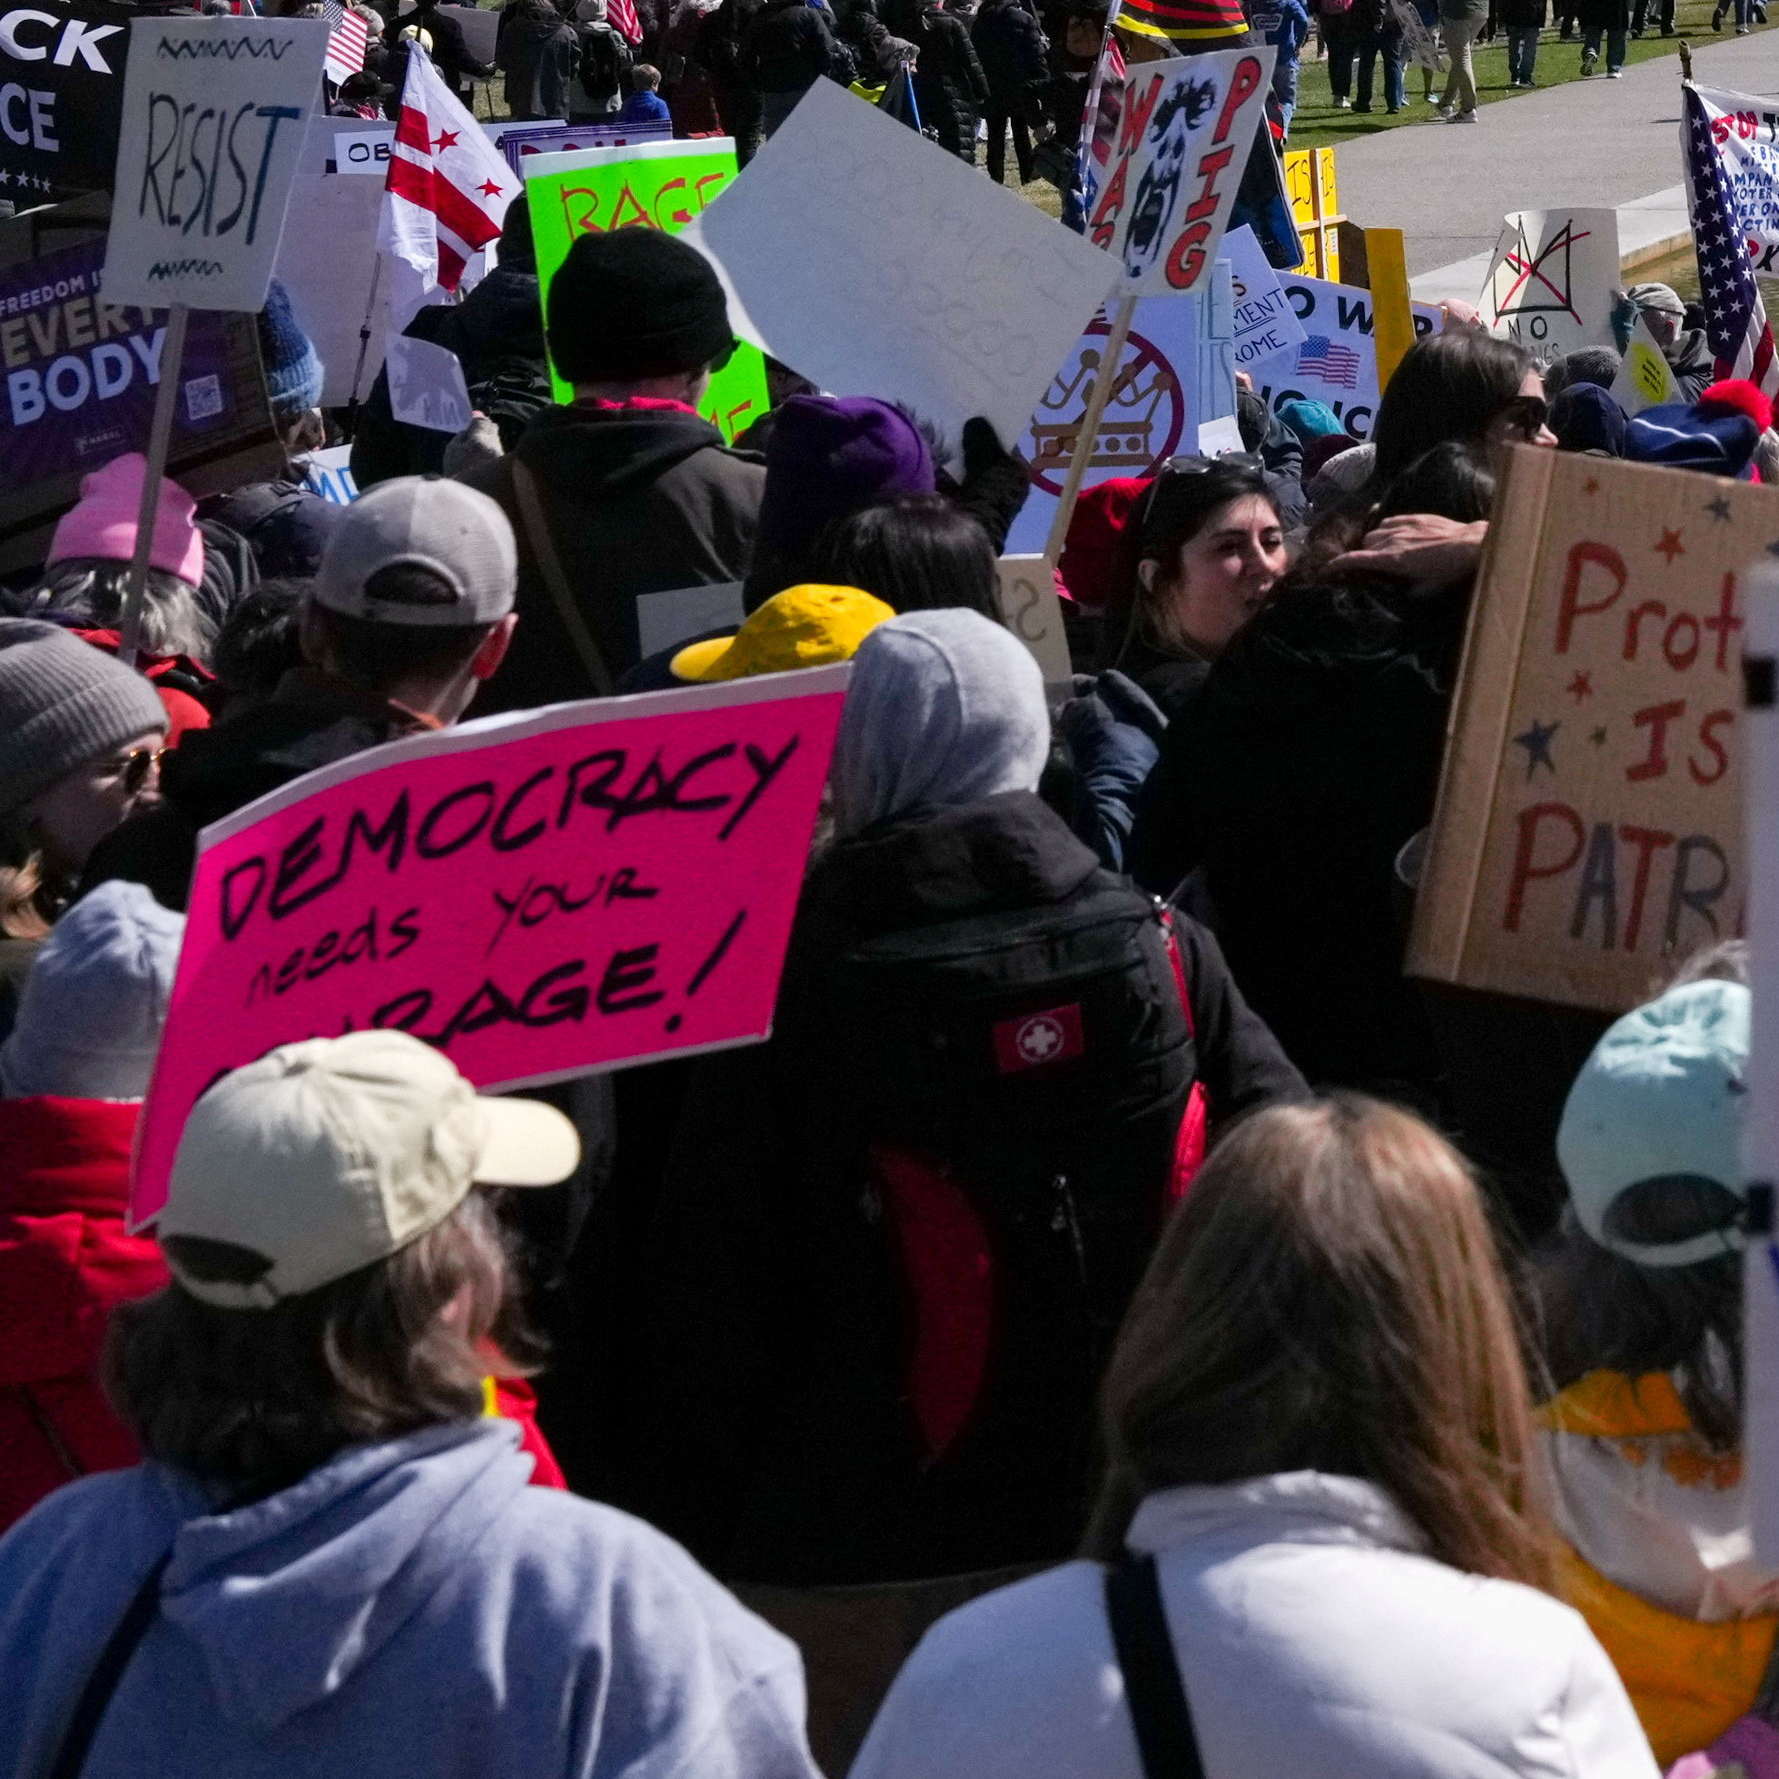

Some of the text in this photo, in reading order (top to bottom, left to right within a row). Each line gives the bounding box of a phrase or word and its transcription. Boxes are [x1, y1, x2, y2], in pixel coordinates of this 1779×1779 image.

[139, 91, 302, 245] RESIST
[1164, 56, 1262, 291] PIG
[1711, 111, 1759, 144] STOP
[0, 275, 86, 316] FREEDOM
[1508, 315, 1548, 342] NO
[7, 325, 169, 427] BODY
[1625, 697, 1737, 788] IS
[217, 734, 801, 943] DEMOCRACY
[1503, 801, 1747, 954] PATR
[243, 865, 661, 1011] needs YOUR
